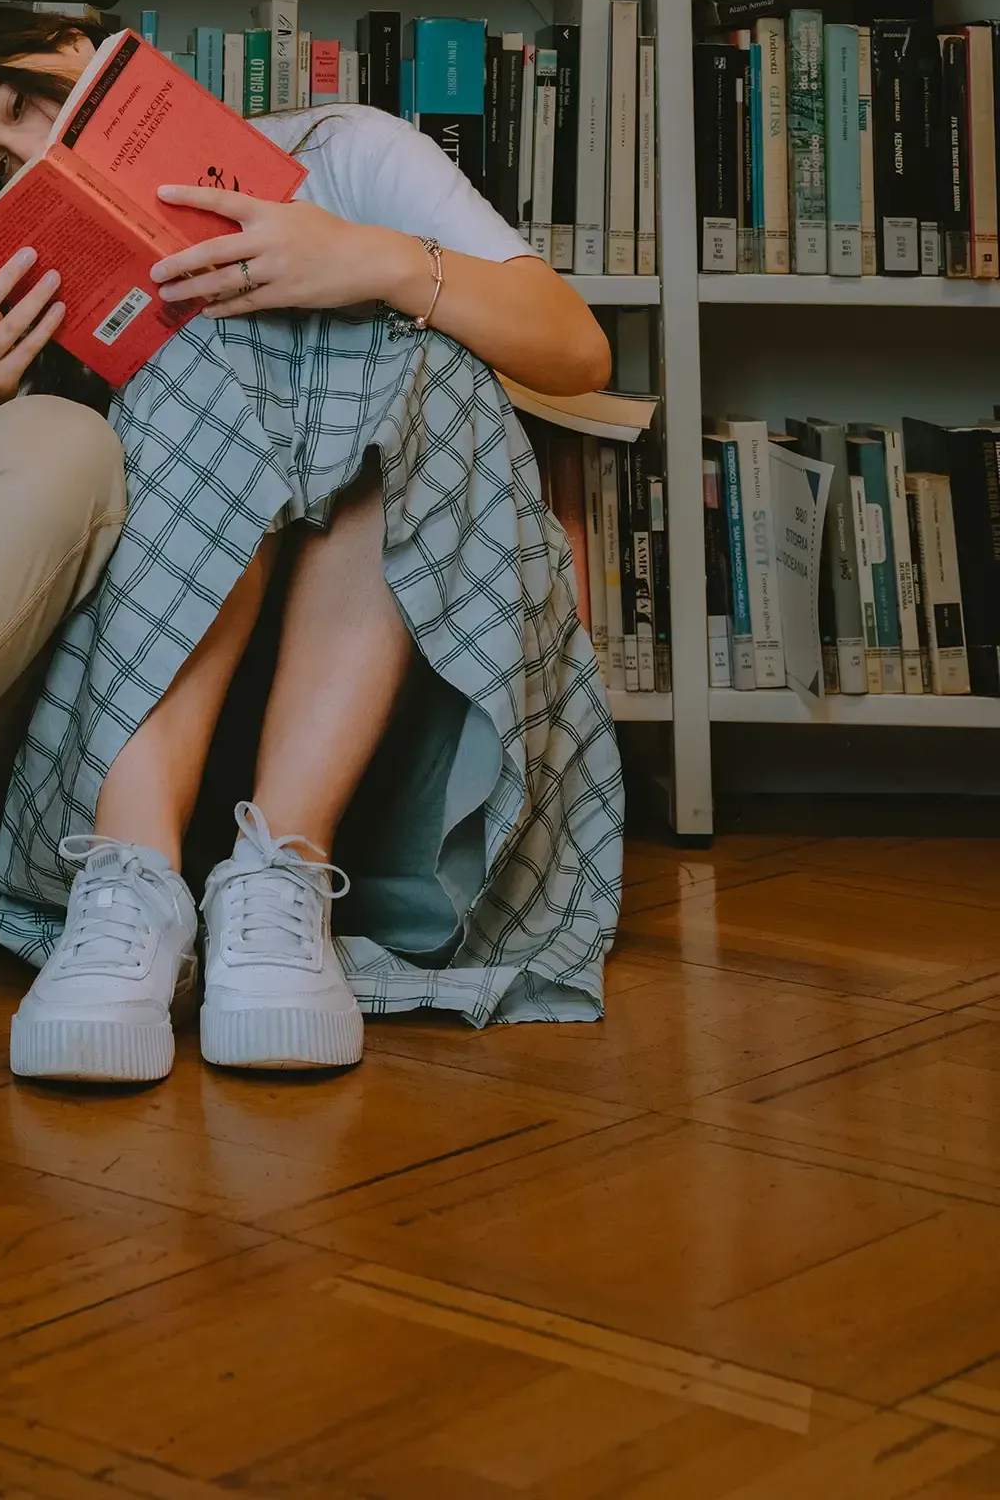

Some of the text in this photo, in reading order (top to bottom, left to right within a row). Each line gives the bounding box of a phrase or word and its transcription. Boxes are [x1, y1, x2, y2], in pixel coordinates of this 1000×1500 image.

[729, 4, 748, 14] Alain
[250, 57, 265, 93] GIALLO
[446, 40, 457, 95] BENNY MORRIS
[769, 30, 778, 75] Andreotti
[71, 106, 93, 136] Piccola
[90, 66, 118, 107] Biblioteca
[277, 62, 289, 105] GUERRA
[103, 84, 142, 140] Jeremy Bernstein
[110, 79, 174, 173] UOMINI E MACCHINE
[127, 101, 173, 166] INTELLIGENTI
[894, 132, 904, 175] KENNEDY
[750, 439, 761, 499] Diana Preston
[727, 446, 746, 618] FEDERICO RAMPINI SAN FRANCISCO MILANO
[752, 511, 770, 568] SCOTT
[785, 528, 809, 552] STORIA
[795, 506, 807, 525] 980
